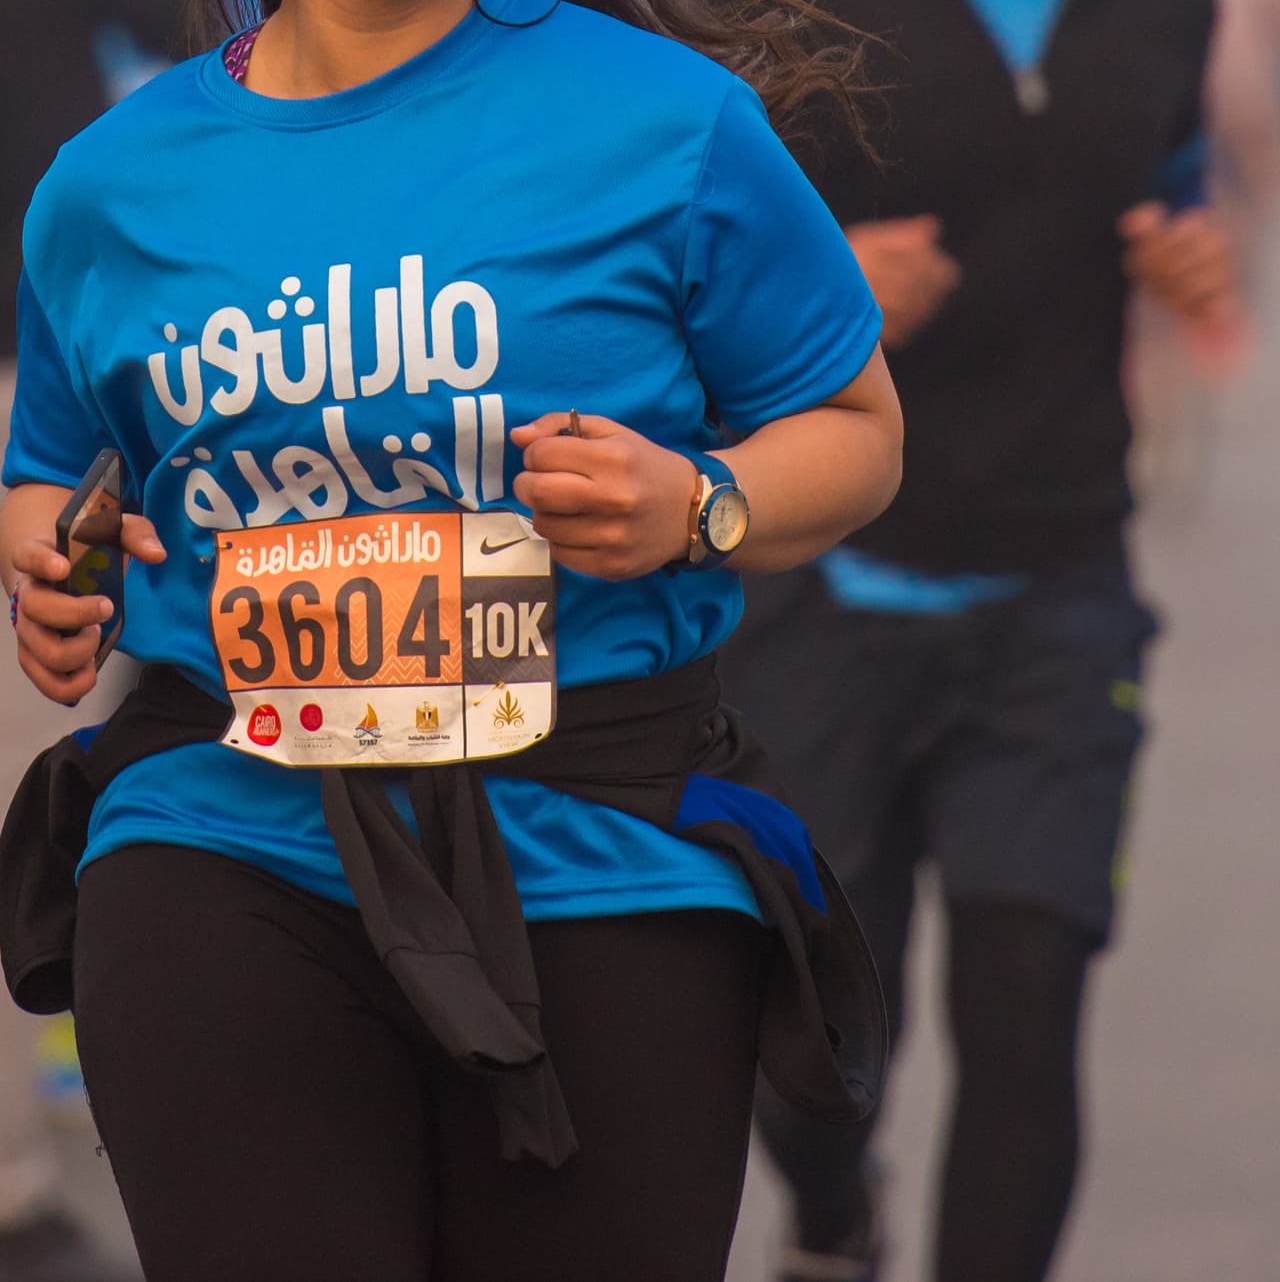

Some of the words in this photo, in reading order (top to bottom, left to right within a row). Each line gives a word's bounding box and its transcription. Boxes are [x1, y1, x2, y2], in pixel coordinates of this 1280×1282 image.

[147, 254, 499, 426] ماراثون
[236, 528, 334, 577] القاهرة
[337, 521, 441, 567] ماراثون
[220, 575, 451, 684] 3604
[465, 601, 550, 659] 10K
[255, 715, 276, 727] CAIRO
